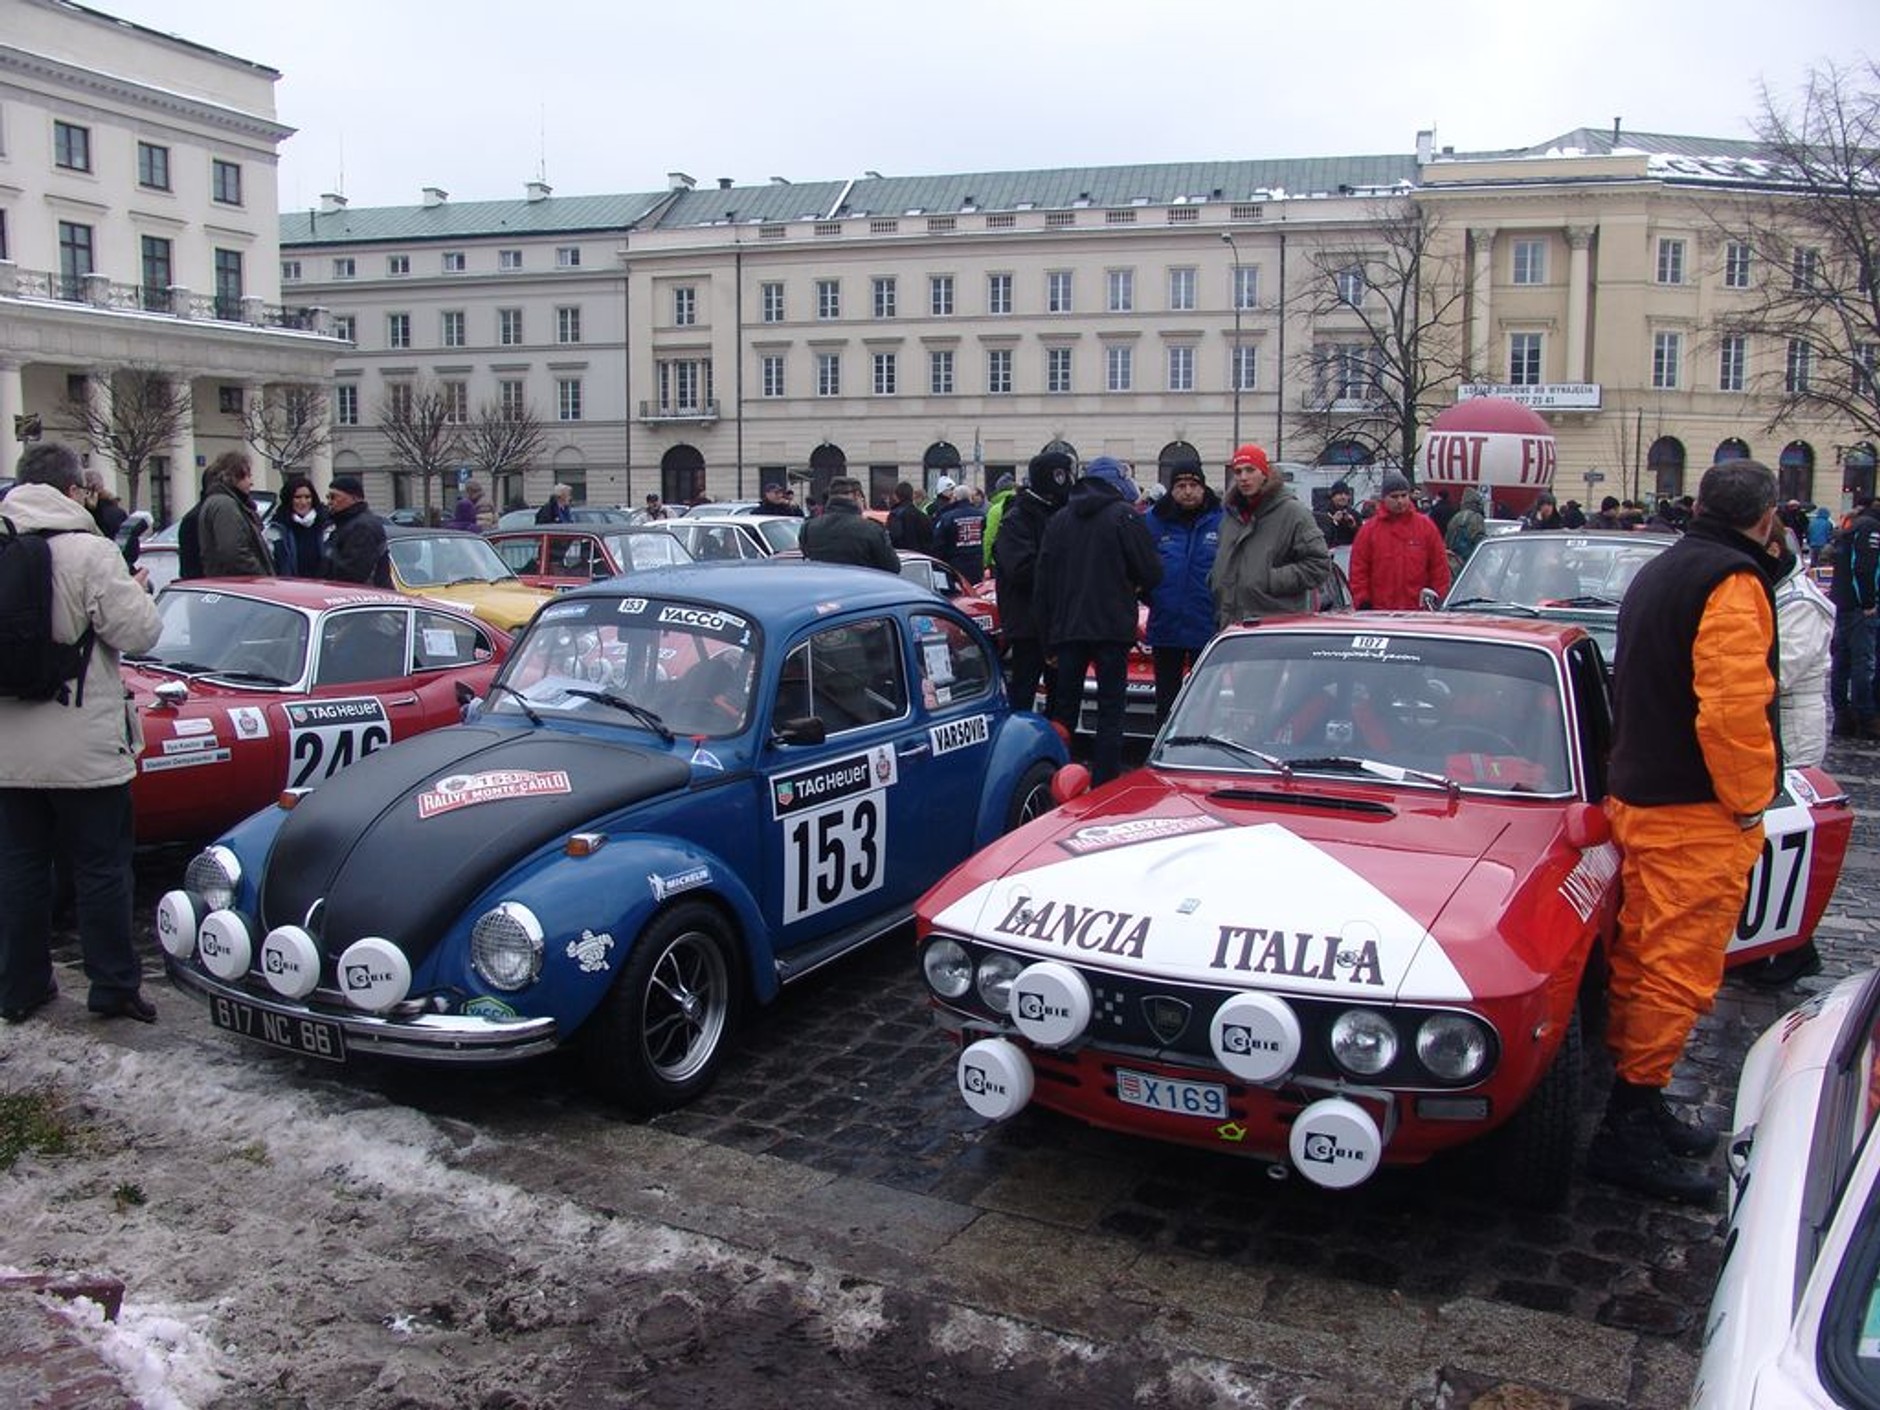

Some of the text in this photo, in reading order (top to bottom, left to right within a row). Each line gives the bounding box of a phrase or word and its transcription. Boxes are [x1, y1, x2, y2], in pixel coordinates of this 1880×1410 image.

[1426, 434, 1489, 482] FIAT
[622, 600, 644, 612] 153
[663, 608, 724, 628] YACCO
[1359, 637, 1384, 649] 107
[934, 717, 986, 752] VARSOVIE
[792, 800, 878, 914] 153
[993, 896, 1152, 960] LANCIA
[1209, 925, 1385, 986] ITALIA
[218, 1001, 332, 1056] 617 NC 66
[1143, 1083, 1222, 1114] X169
